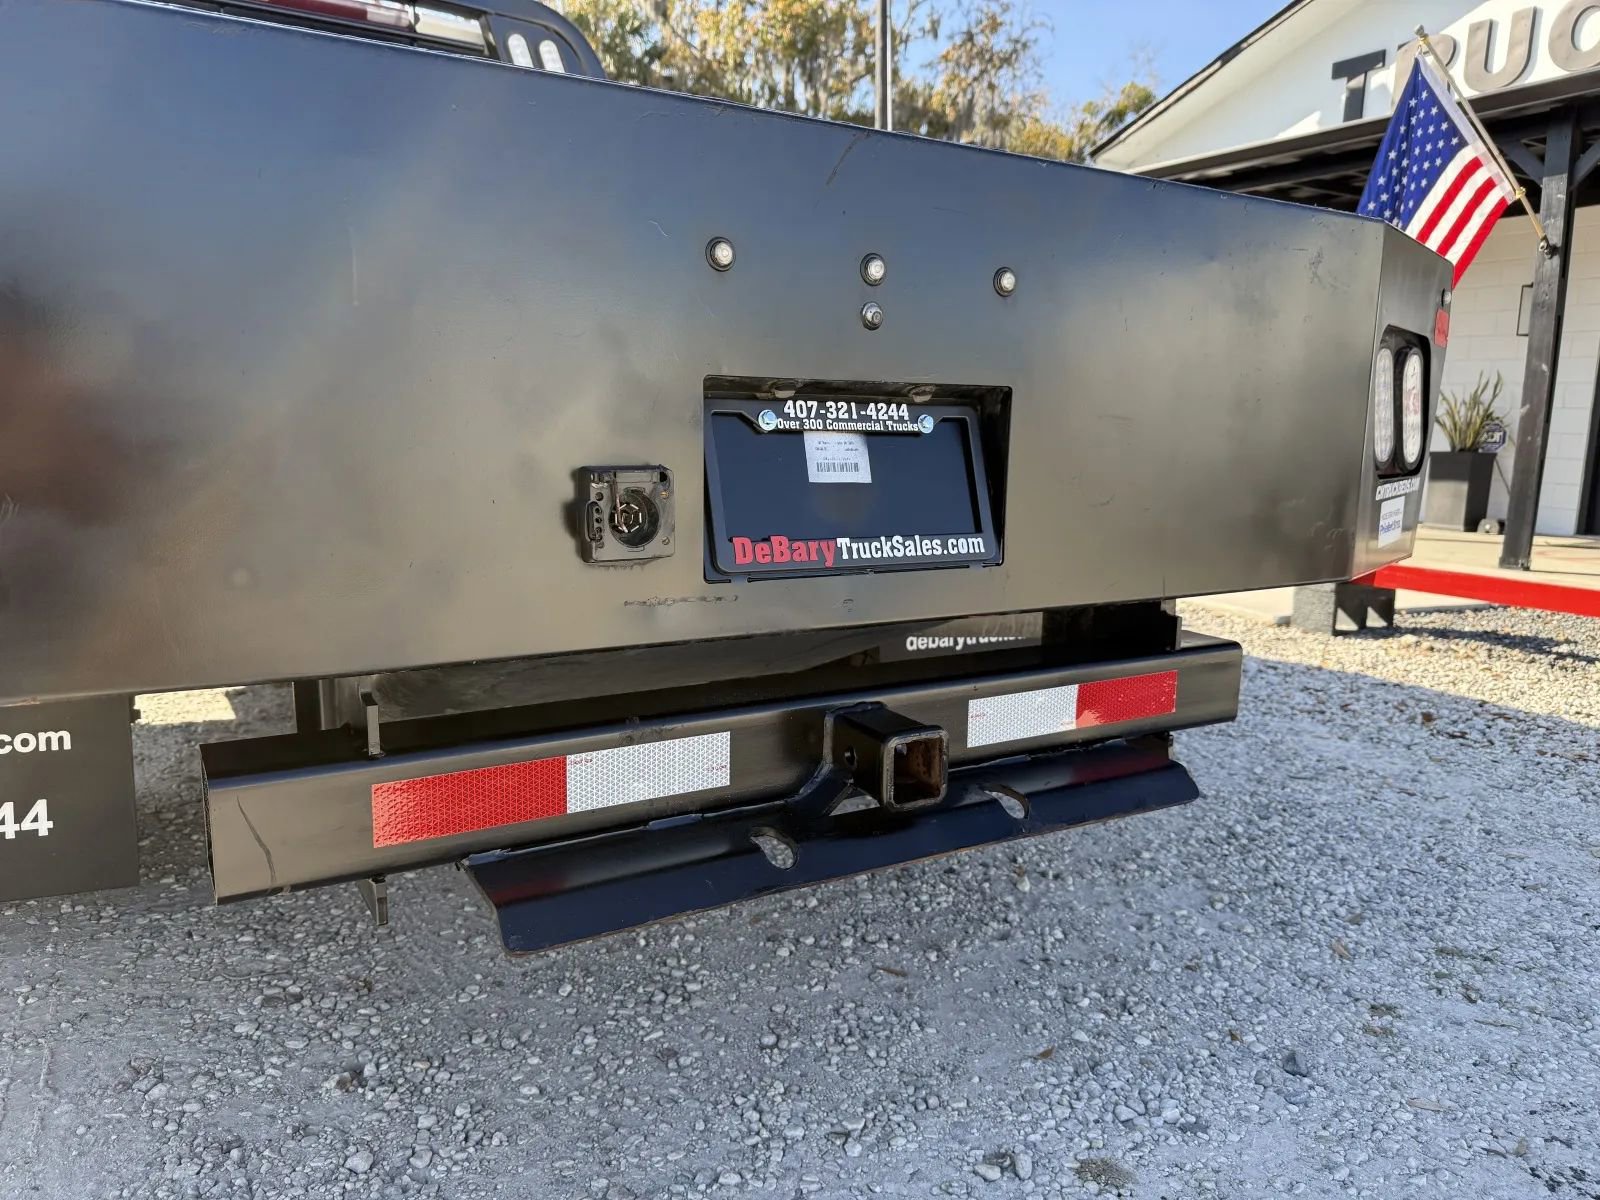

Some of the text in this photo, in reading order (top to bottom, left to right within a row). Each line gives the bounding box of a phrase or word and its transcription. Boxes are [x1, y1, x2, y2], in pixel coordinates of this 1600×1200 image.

[783, 400, 909, 421] 407-321-4244
[777, 418, 919, 432] Over 300 Commercial Trucks
[732, 535, 985, 568] DeBaryTruckSales.com
